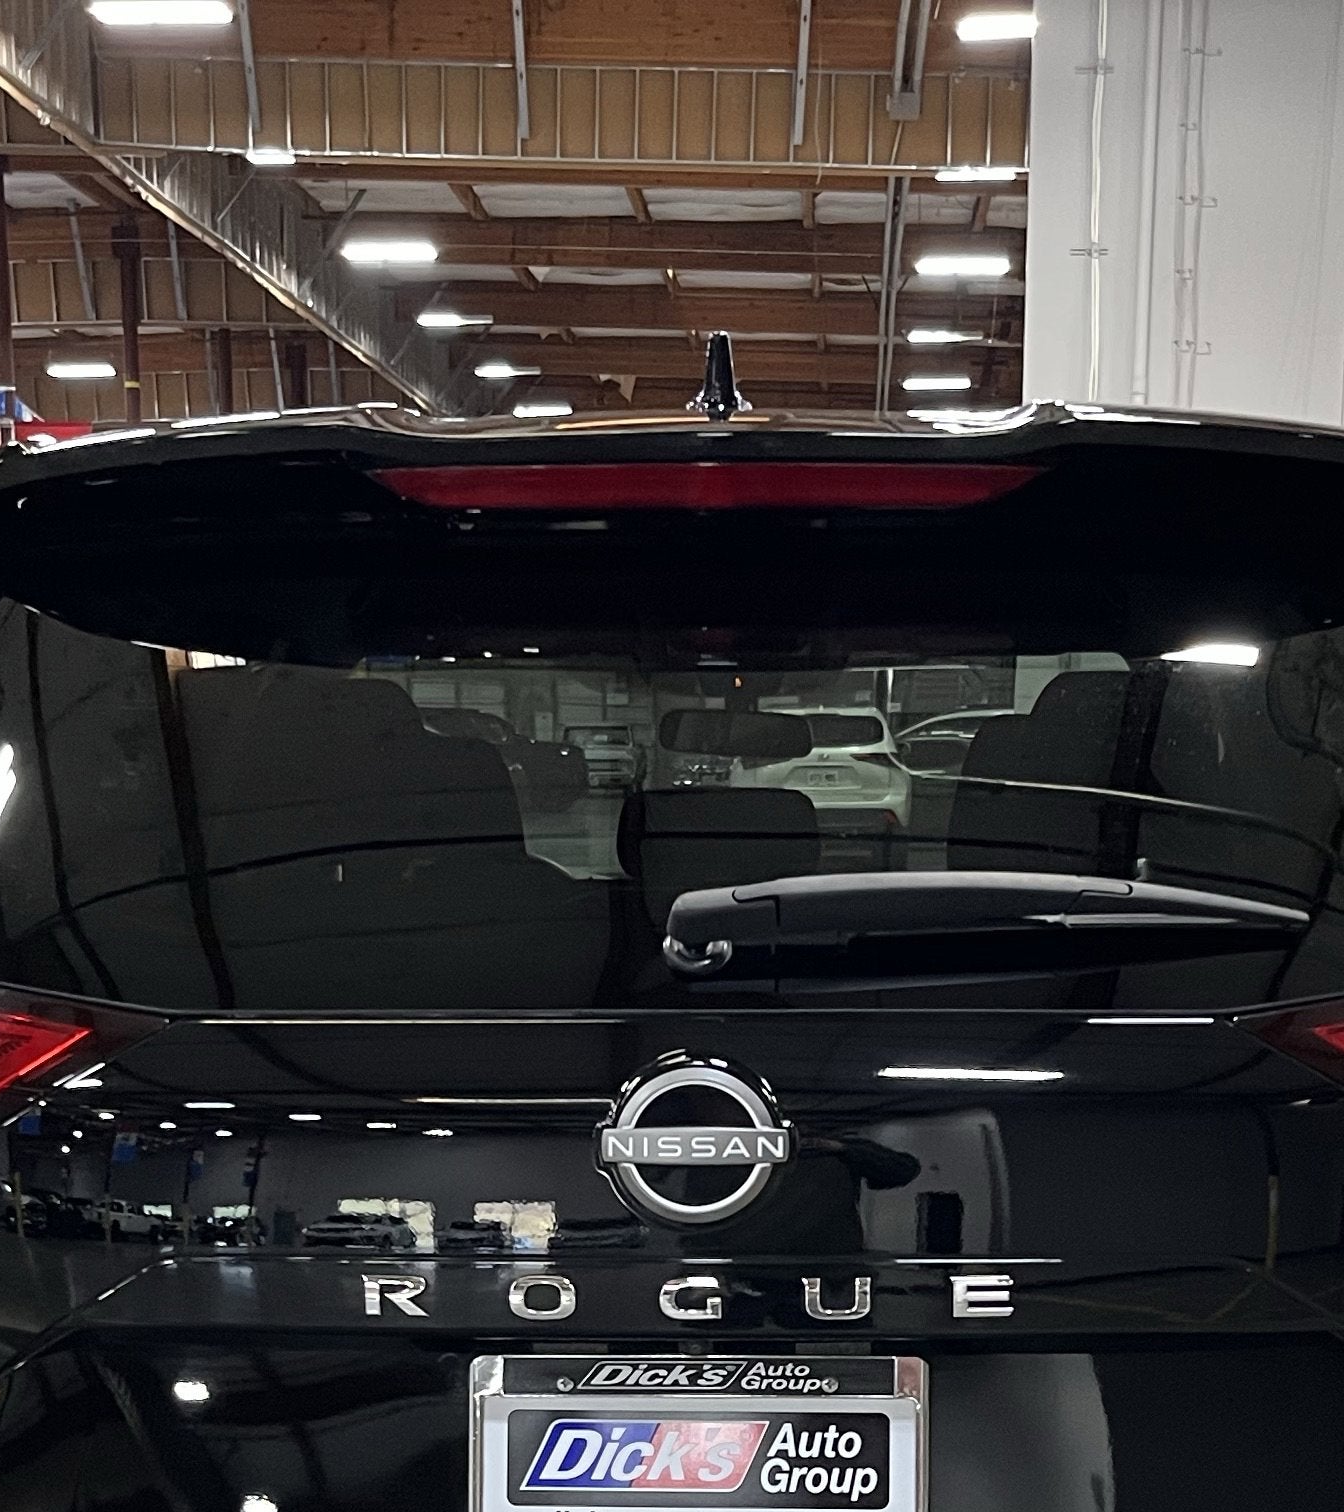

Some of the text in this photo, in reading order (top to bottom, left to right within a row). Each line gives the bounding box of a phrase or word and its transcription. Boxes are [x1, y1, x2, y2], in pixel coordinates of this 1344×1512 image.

[608, 1136, 784, 1158] NISSAN
[362, 1275, 1015, 1322] ROGUE
[590, 1362, 810, 1386] Dick's Auto
[741, 1375, 822, 1393] Group
[536, 1422, 862, 1482] Dick's Auto
[760, 1458, 878, 1502] Group
